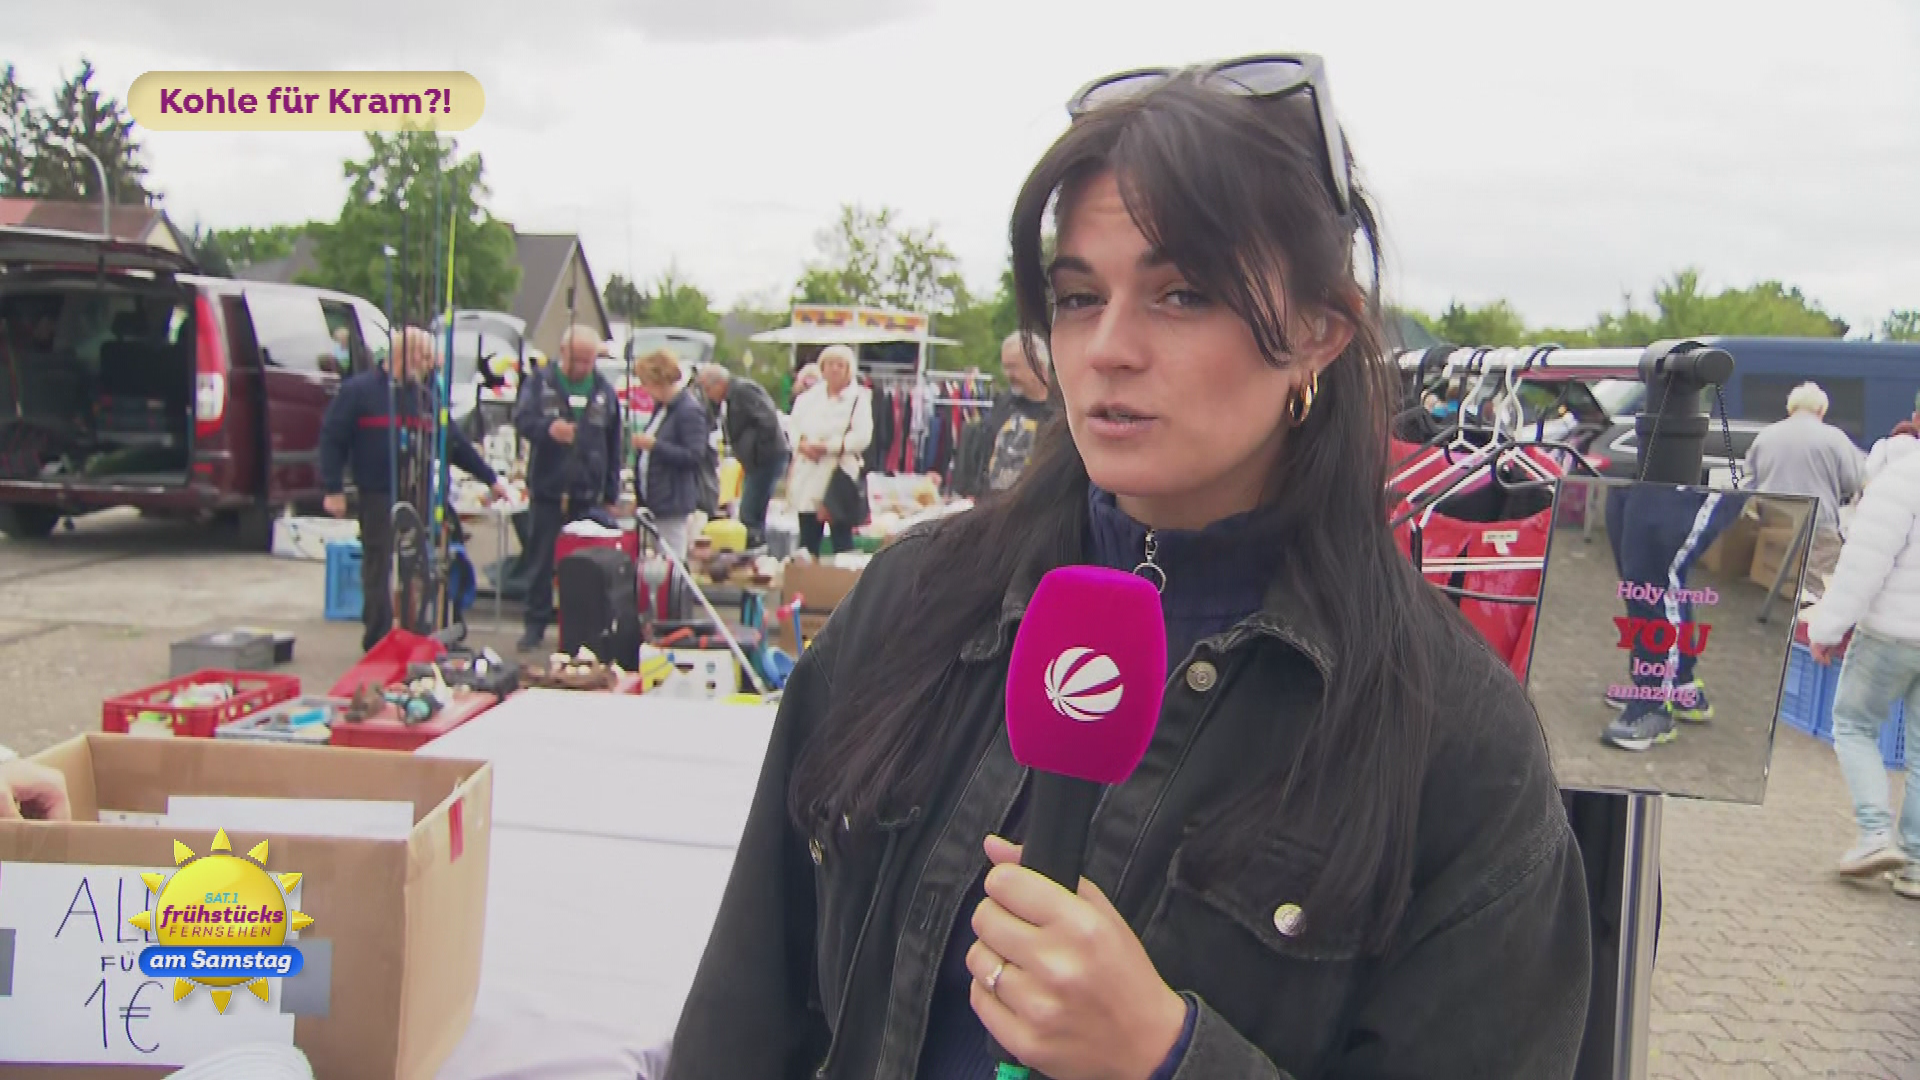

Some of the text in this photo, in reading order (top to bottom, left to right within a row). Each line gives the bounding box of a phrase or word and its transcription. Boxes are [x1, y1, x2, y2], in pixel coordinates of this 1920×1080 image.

[1616, 580, 1664, 605] Holy
[1612, 616, 1712, 656] YOU
[1633, 657, 1677, 678] look
[1606, 684, 1697, 707] amazing
[55, 877, 160, 943] ALL
[101, 951, 136, 972] FÜ
[84, 979, 164, 1053] 1€
